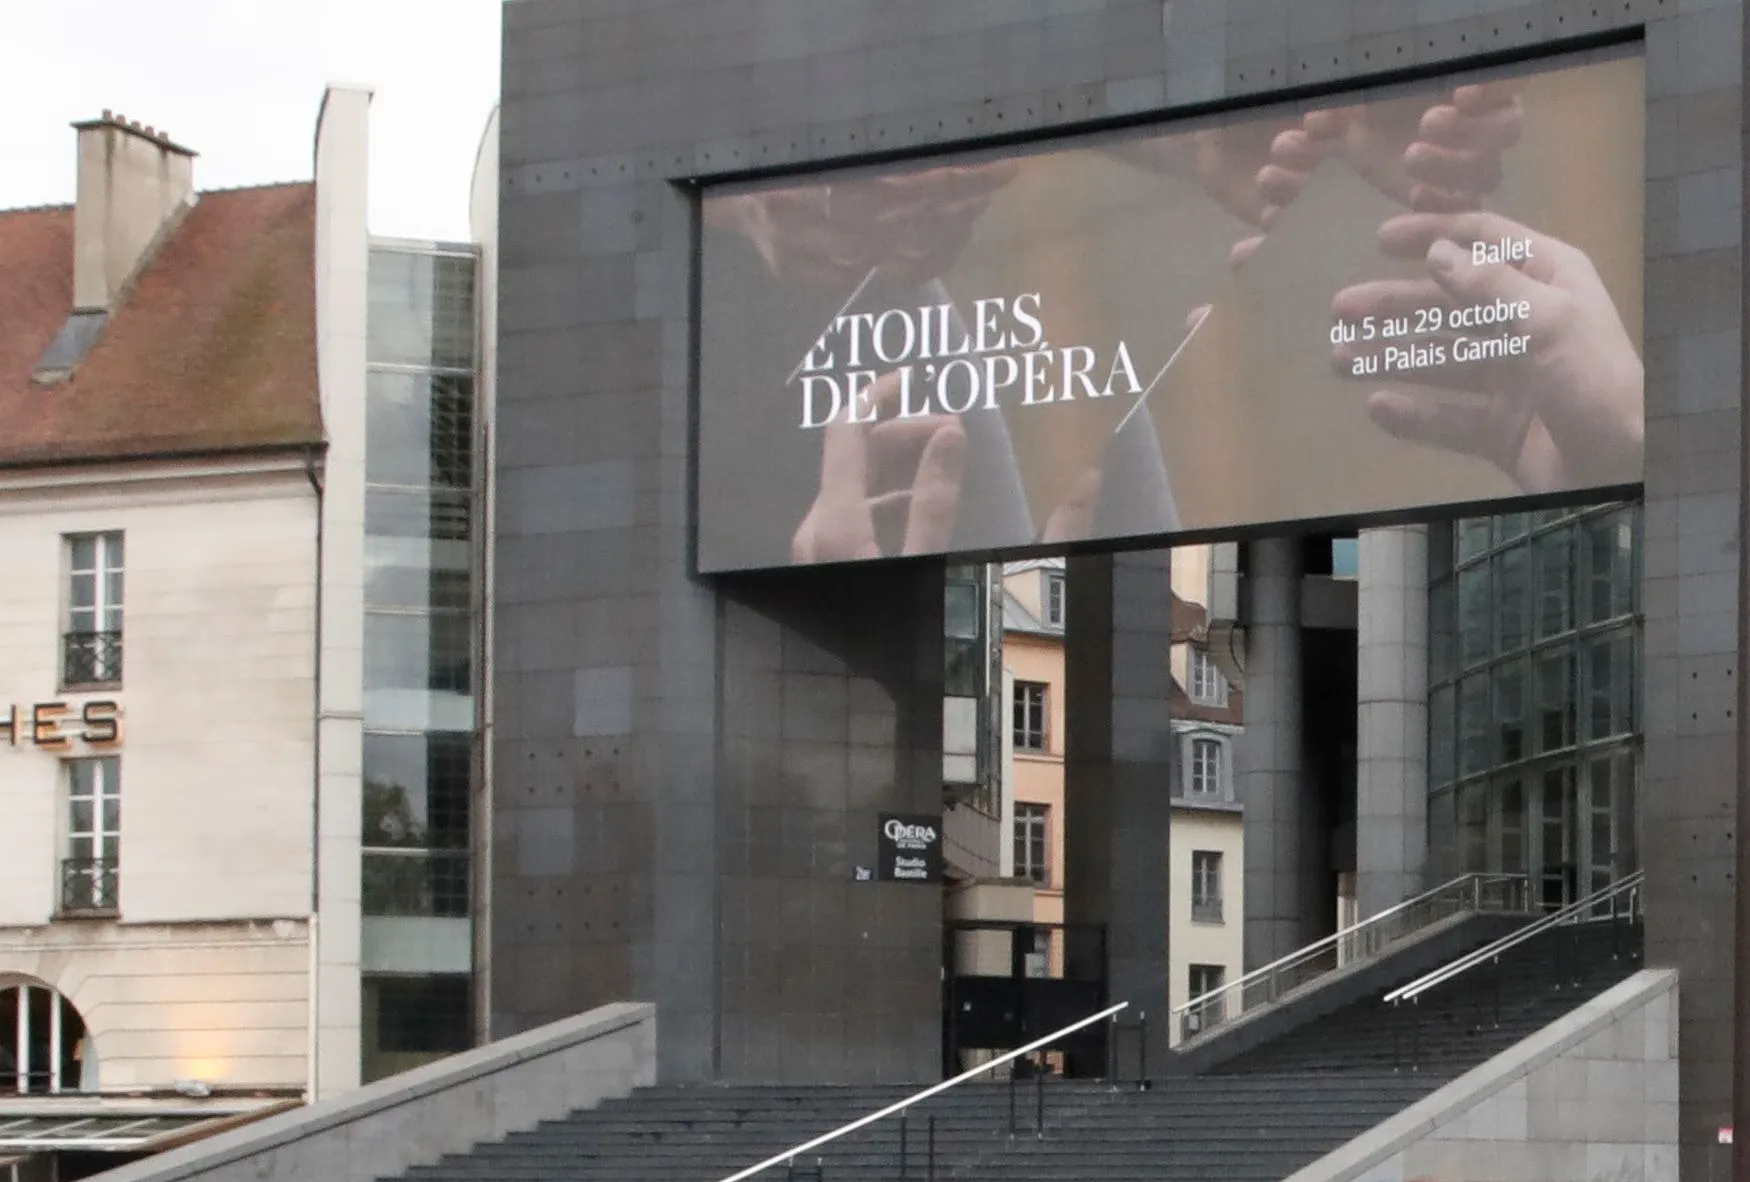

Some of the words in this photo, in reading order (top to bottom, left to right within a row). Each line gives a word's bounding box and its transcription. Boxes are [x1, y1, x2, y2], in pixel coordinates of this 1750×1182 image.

[1472, 237, 1534, 266] Ballet
[1330, 319, 1355, 344] du
[1362, 316, 1375, 340] 5
[1382, 317, 1408, 338] au
[1414, 307, 1442, 334] 29
[1449, 297, 1530, 329] octobre
[1352, 355, 1378, 375] au
[1385, 343, 1446, 371] Palais
[1453, 333, 1531, 362] Garnier
[799, 371, 878, 429] DE
